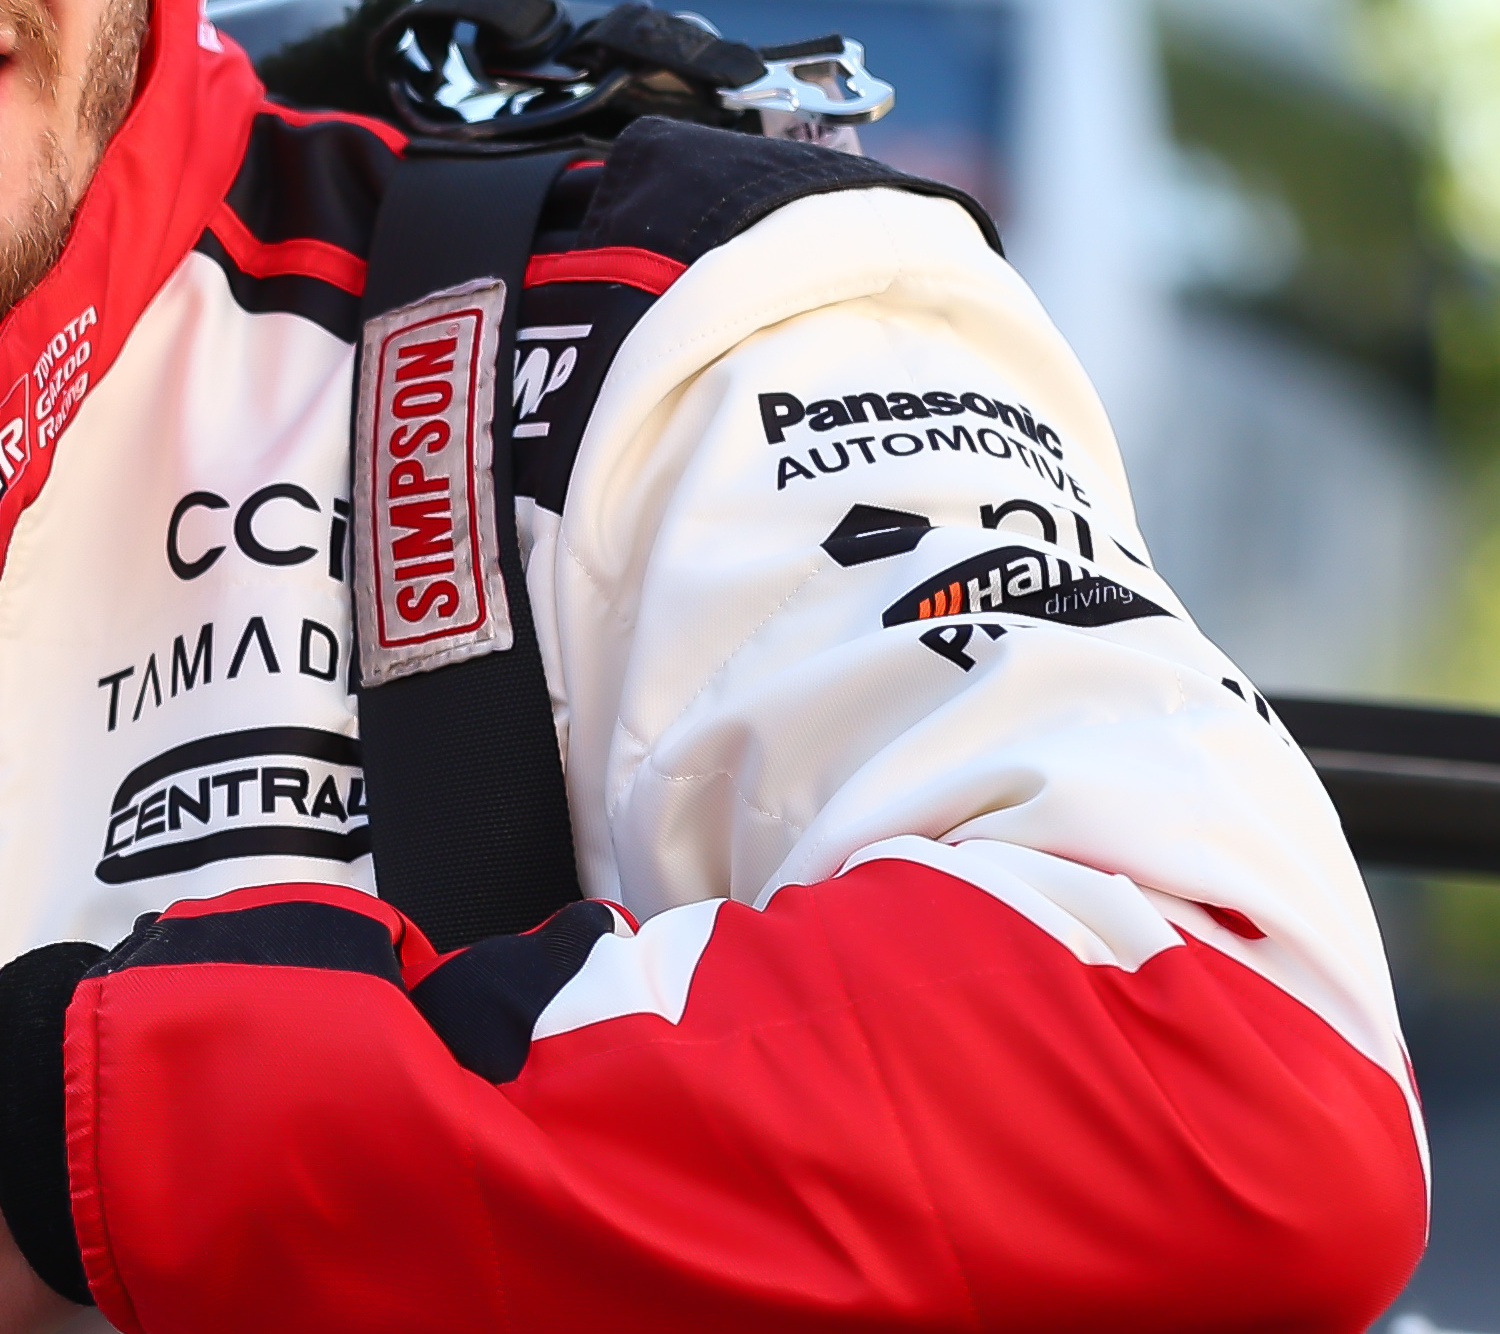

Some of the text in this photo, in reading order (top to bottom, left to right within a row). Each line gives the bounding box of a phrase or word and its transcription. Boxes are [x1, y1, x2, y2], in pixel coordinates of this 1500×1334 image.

[33, 304, 97, 390] TOYOTA
[35, 340, 91, 420] GAZOO
[37, 371, 89, 448] Racing
[758, 391, 1064, 460] Panasonic
[389, 337, 459, 623] SIMPSON
[777, 425, 1092, 508] AUTOMOTIVE
[966, 554, 1099, 614] Han
[1045, 582, 1133, 615] driving
[99, 616, 338, 731] TAMAD
[103, 767, 370, 859] CENTRAL
